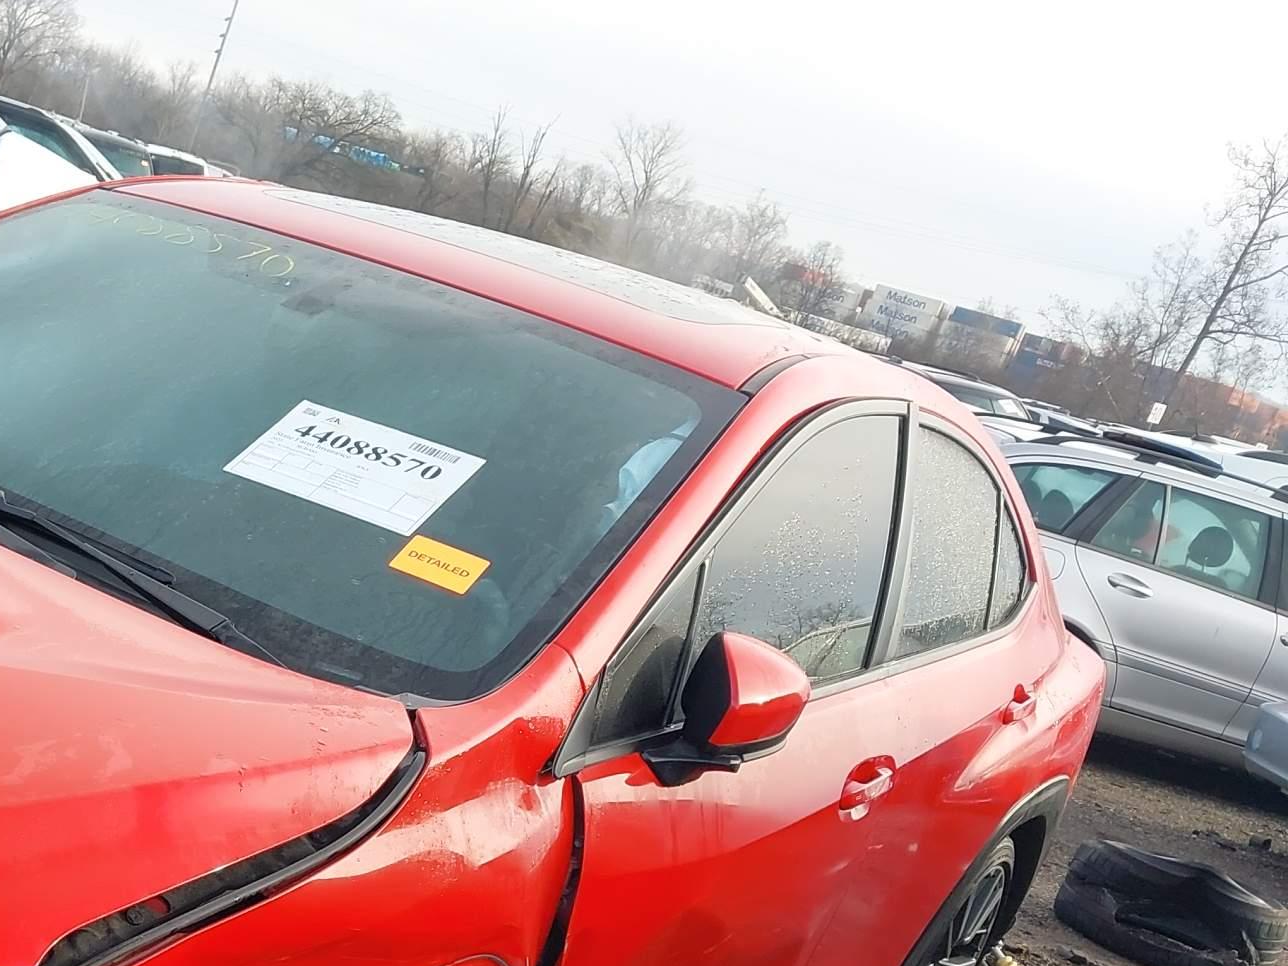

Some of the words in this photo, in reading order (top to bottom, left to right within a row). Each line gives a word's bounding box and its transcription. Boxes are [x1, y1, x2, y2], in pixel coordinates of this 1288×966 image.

[886, 290, 927, 310] Matson
[293, 423, 444, 481] 44088570
[407, 549, 471, 579] DETAILED
